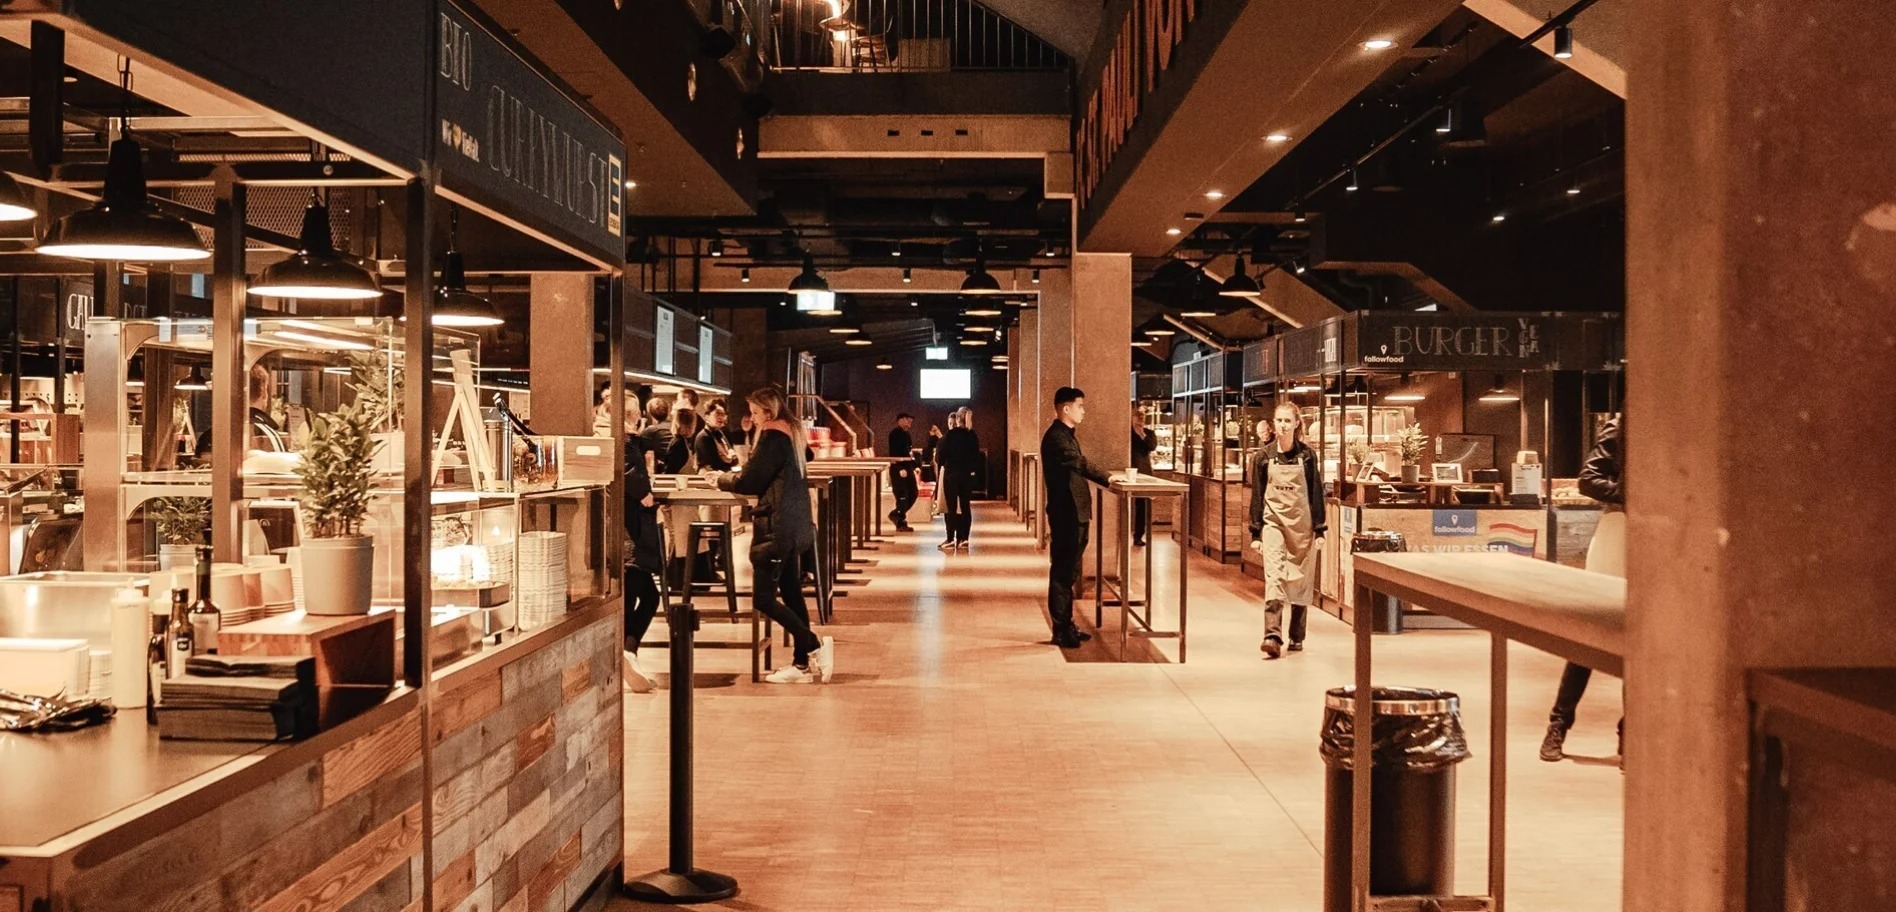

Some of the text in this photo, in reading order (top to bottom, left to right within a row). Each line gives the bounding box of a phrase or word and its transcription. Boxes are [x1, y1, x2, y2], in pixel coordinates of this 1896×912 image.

[440, 12, 472, 91] BIO
[487, 85, 608, 229] CURRYWURST
[1391, 326, 1513, 357] BURGER
[1364, 355, 1405, 363] followfood
[1434, 525, 1476, 533] followfood
